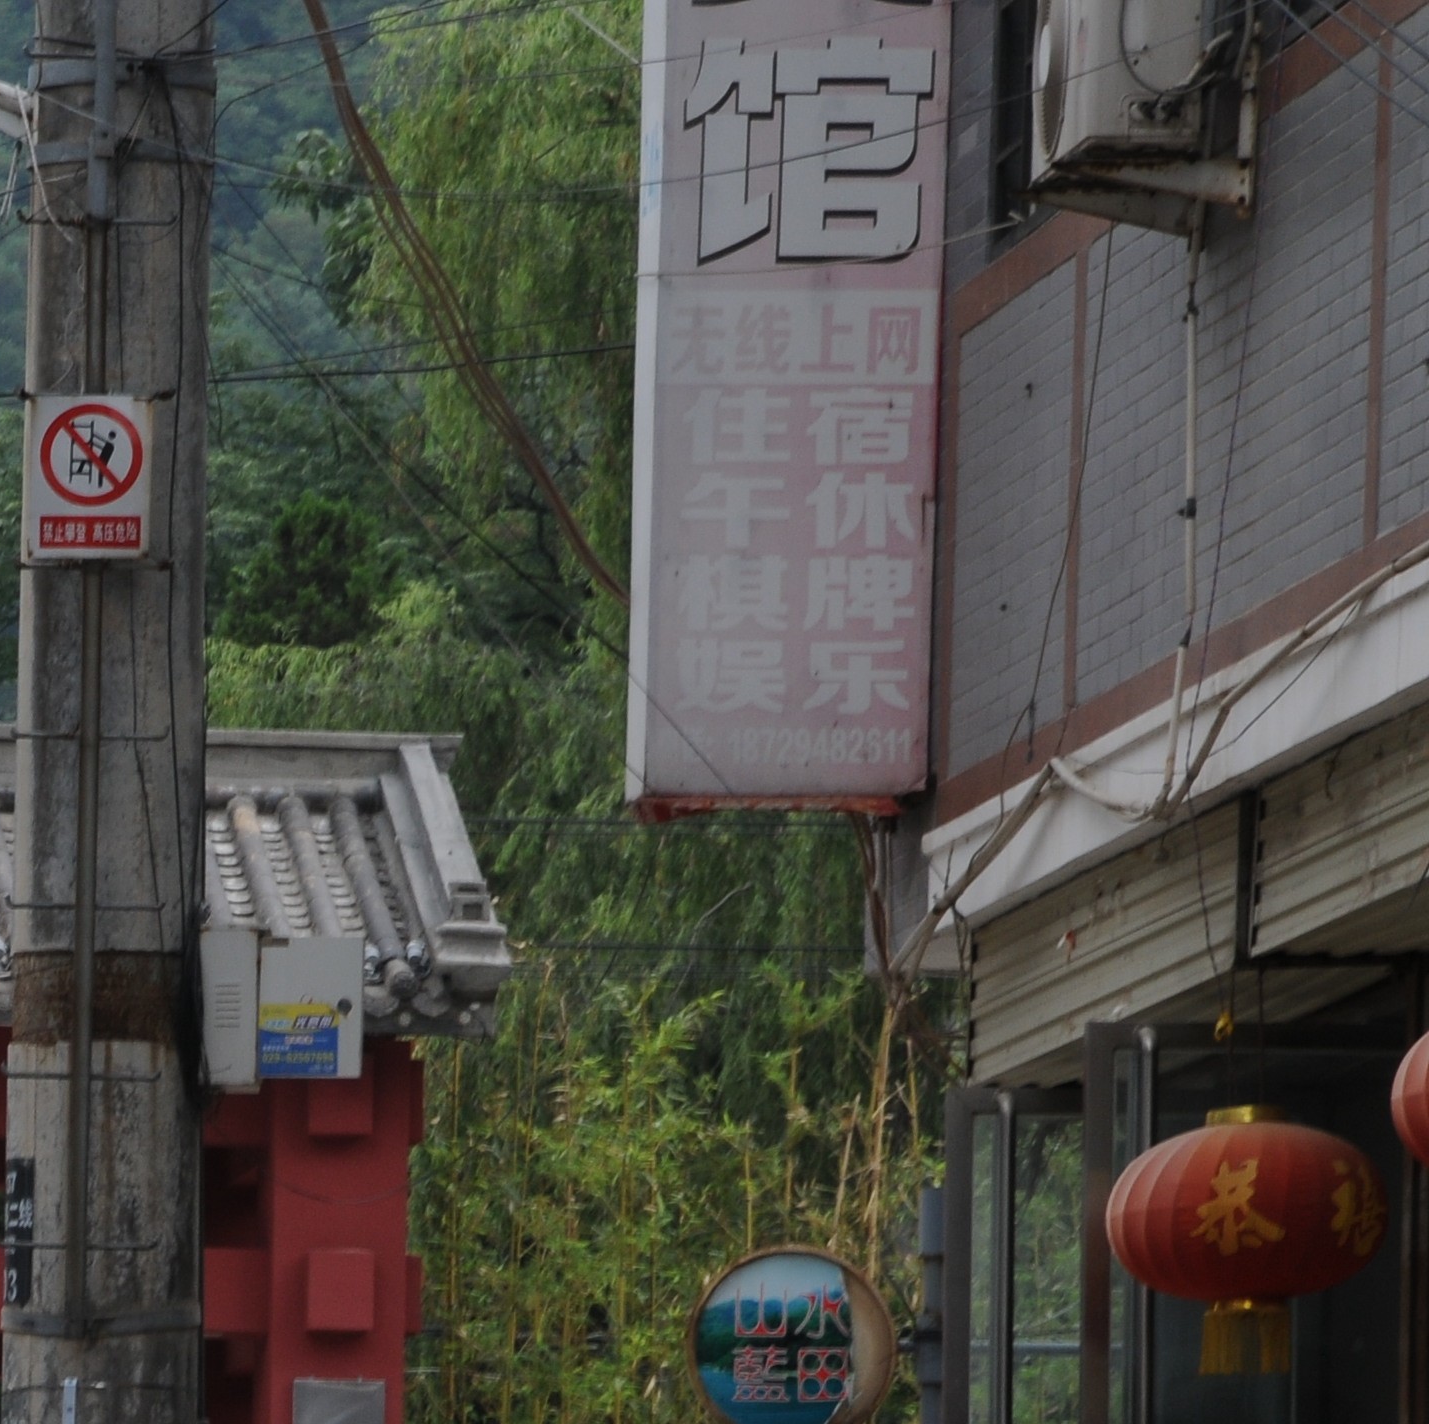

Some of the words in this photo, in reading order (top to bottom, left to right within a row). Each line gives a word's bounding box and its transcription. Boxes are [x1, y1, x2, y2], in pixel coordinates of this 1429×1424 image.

[685, 0, 935, 265] 馆
[671, 305, 921, 376] 无线上网
[682, 388, 914, 465] 住宿
[92, 521, 138, 544] 高压危险
[680, 471, 915, 549] 午休
[678, 554, 915, 632] 棋牌
[675, 638, 910, 714] 娱乐
[734, 1282, 852, 1340] 山水
